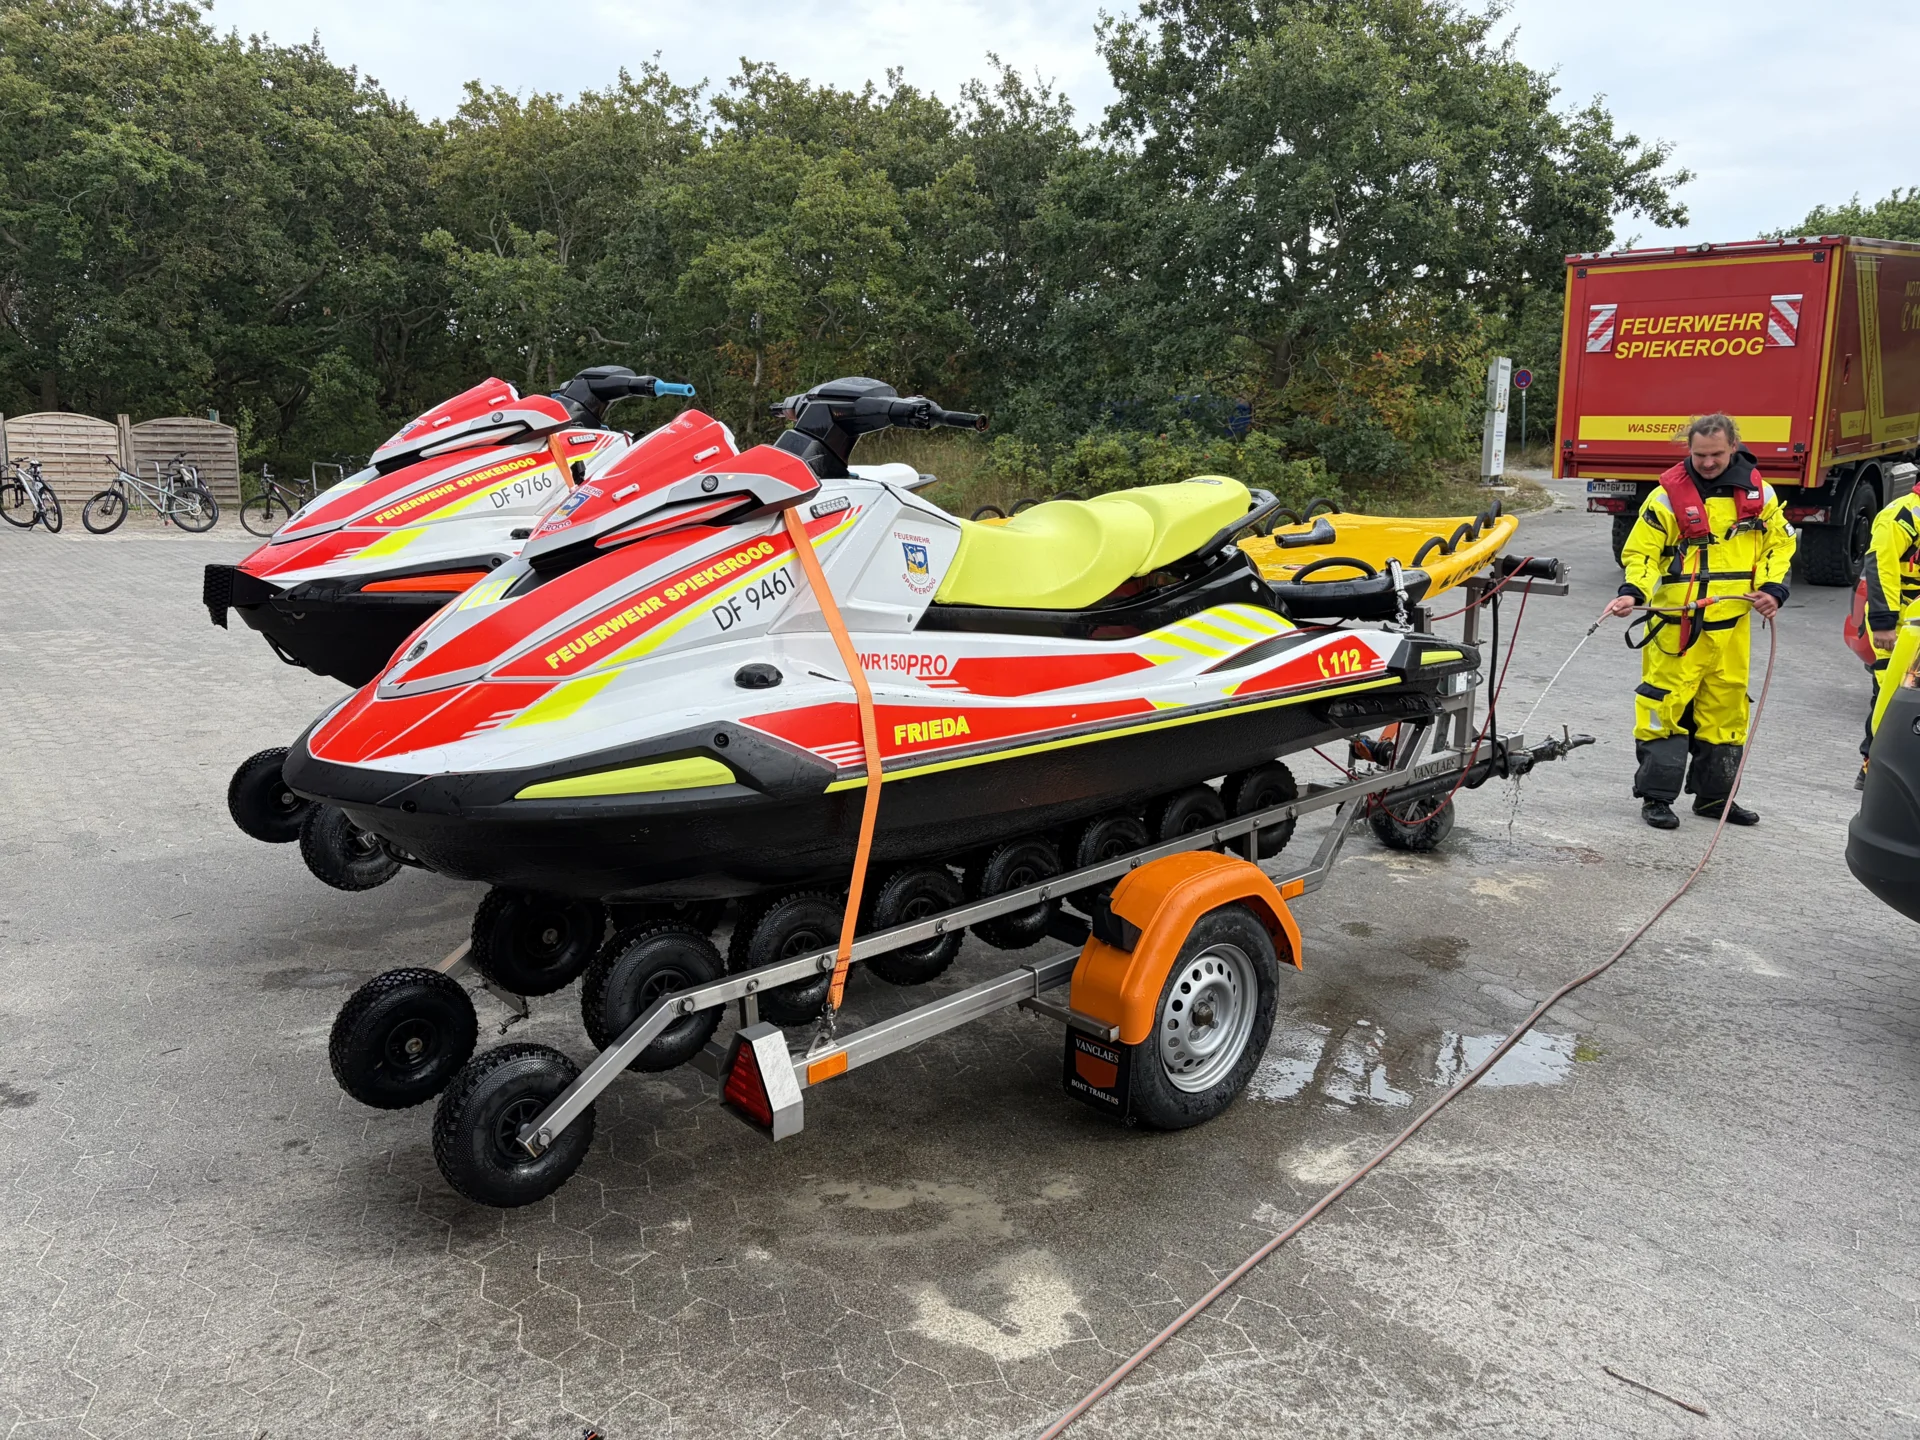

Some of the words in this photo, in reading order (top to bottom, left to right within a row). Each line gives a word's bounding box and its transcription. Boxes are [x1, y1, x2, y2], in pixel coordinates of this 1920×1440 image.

[1619, 312, 1764, 335] FEUERWEHR
[1615, 336, 1765, 359] SPIEKEROOG
[375, 484, 457, 524] FEUERWEHR
[457, 457, 537, 488] SPIEKEROOG
[489, 487, 513, 509] DF
[514, 472, 552, 499] 9766
[893, 531, 931, 544] FEUERWEHR
[902, 573, 936, 595] SPIEKEROOG
[545, 596, 667, 670] FEUERWEHR
[663, 541, 775, 602] SPIEKEROOG
[712, 596, 744, 631] DF
[745, 566, 795, 611] 9461
[1330, 648, 1362, 675] 112
[894, 715, 971, 746] FRIEDA
[1413, 757, 1456, 779] VANCLAES
[1076, 1038, 1119, 1064] VANCLAES
[1071, 1078, 1087, 1092] BOAT
[1088, 1087, 1119, 1106] TRAILERS
